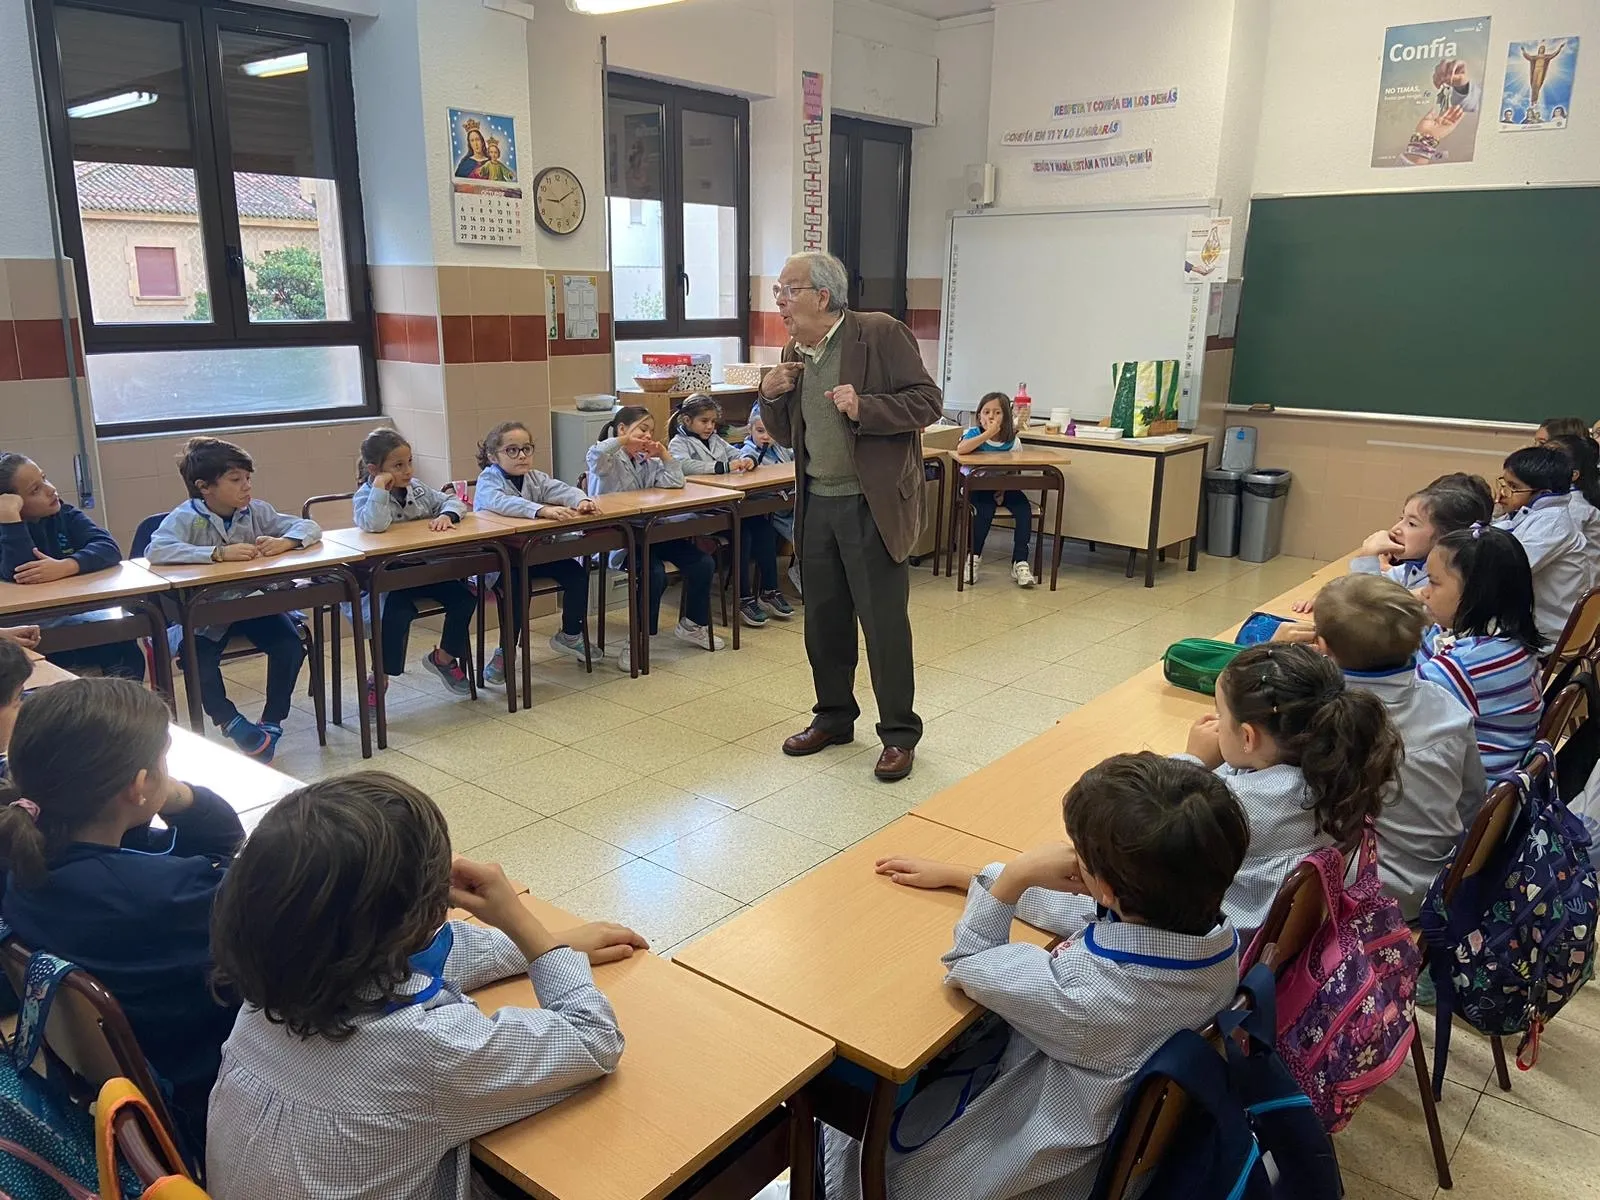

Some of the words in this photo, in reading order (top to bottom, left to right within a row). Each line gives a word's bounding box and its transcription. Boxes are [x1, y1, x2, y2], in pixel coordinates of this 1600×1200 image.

[1389, 36, 1457, 62] Confía
[1385, 87, 1396, 95] NO
[1053, 103, 1086, 117] RESPETA
[1086, 101, 1093, 113] Y
[1121, 96, 1133, 109] EN
[1134, 95, 1150, 108] LOS
[1034, 130, 1047, 142] EN
[1056, 129, 1064, 140] Y
[1063, 127, 1075, 139] LO
[1049, 161, 1055, 172] Y
[1094, 158, 1100, 169] A
[1100, 156, 1109, 169] TU
